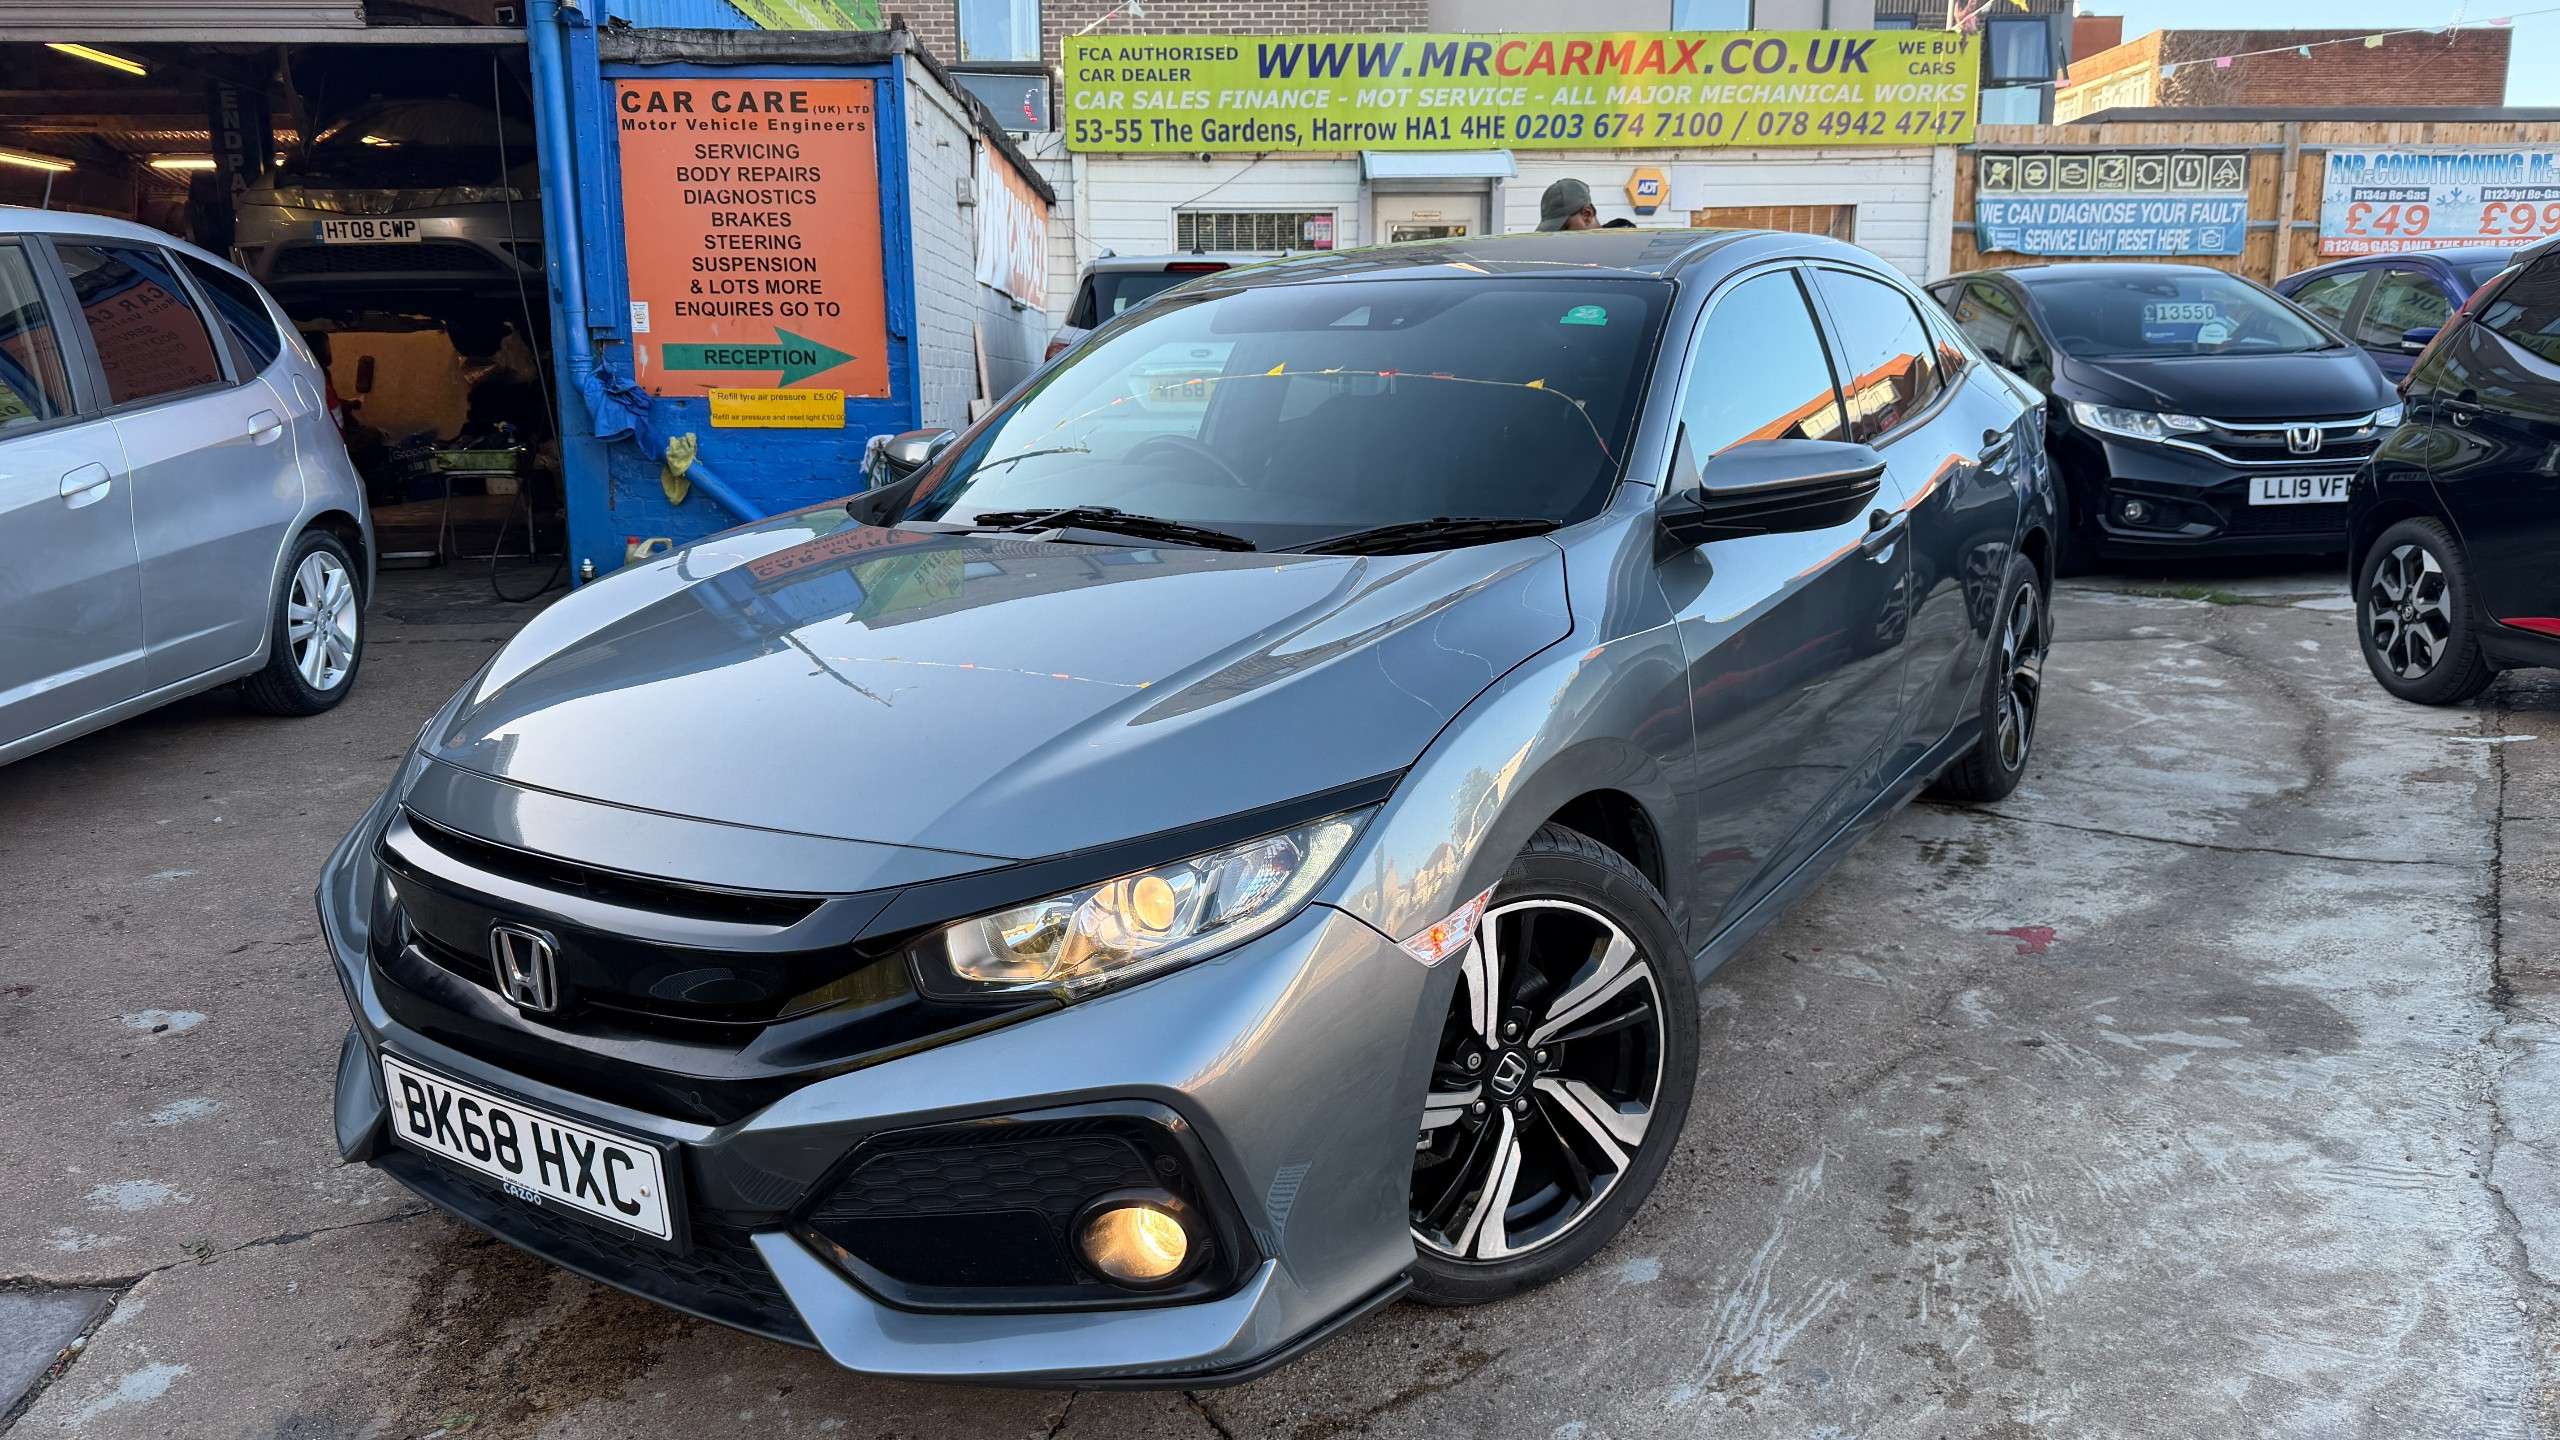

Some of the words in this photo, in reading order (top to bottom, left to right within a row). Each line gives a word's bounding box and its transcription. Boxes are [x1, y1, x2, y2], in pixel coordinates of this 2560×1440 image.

[1078, 47, 1113, 61] FCA
[1118, 46, 1239, 61] AUTHORISED
[1898, 41, 1927, 55] WE
[1932, 40, 1968, 56] BUY
[1257, 38, 1877, 79] WWW.MRCARMAX.CO.UK
[1079, 68, 1116, 82] CAR
[1121, 68, 1192, 82] DEALER
[1908, 61, 1956, 76] CARS
[620, 90, 694, 114] CAR
[711, 90, 809, 114] CARE
[812, 105, 842, 116] (UK)
[846, 105, 870, 114] LTD
[1073, 90, 1125, 110] CAR
[1131, 89, 1211, 110] SALES
[1217, 88, 1331, 110] FINANCE
[1355, 88, 1413, 108] MOT
[1416, 87, 1528, 107] SERVICE
[1550, 86, 1597, 105] ALL
[1604, 85, 1692, 105] MAJOR
[1699, 84, 1864, 105] MECHANICAL
[1874, 83, 1969, 103] WORKS
[621, 118, 677, 131] Motor
[686, 118, 758, 131] Vehicle
[767, 118, 866, 134] Engineers
[1075, 119, 1143, 144] 53-55
[1150, 118, 1193, 143] The
[1200, 117, 1303, 147] Gardens,
[1312, 117, 1397, 142] Harrow
[1405, 116, 1451, 141] HA1
[1460, 115, 1506, 140] 4HE
[1515, 113, 1584, 139] 0203
[1593, 112, 1644, 138] 674
[1653, 112, 1723, 138] 7100
[1756, 111, 1809, 137] 078
[1817, 111, 1886, 136] 4942
[1895, 110, 1967, 136] 4747
[694, 143, 800, 159] SERVICING
[676, 167, 731, 182] BODY
[737, 167, 821, 182] REPAIRS
[1637, 181, 1658, 194] ADT
[2527, 188, 2560, 200] Re-Ga
[683, 189, 817, 205] DIAGNOSTICS
[711, 212, 792, 227] BRAKES
[1980, 203, 2004, 224] WE
[2007, 203, 2046, 224] CAN
[2048, 202, 2138, 224] DIAGNOSE
[2140, 202, 2187, 224] YOUR
[2189, 202, 2245, 223] FAULT
[2344, 202, 2431, 236] £49
[2478, 202, 2560, 236] £99
[324, 221, 375, 239] HT08
[379, 221, 416, 238] CWP
[704, 234, 802, 250] STEERING
[2024, 228, 2078, 251] SERVICE
[2078, 228, 2117, 251] LIGHT
[2115, 228, 2157, 251] RESET
[2156, 228, 2193, 250] HERE
[2370, 240, 2400, 253] GAS
[2401, 240, 2432, 252] AND
[692, 257, 817, 272] SUSPENSION
[690, 280, 704, 294] &
[709, 280, 760, 294] LOTS
[765, 280, 822, 294] MORE
[675, 302, 774, 317] ENQUIRES
[780, 302, 809, 317] GO
[815, 302, 841, 316] TO
[704, 350, 817, 366] RECEPTION
[717, 392, 738, 400] Refill
[740, 392, 756, 402] tyre
[758, 392, 768, 400] air
[770, 393, 807, 402] pressure
[742, 414, 772, 422] pressure
[806, 413, 821, 422] light
[2263, 478, 2312, 499] LL19
[398, 1072, 523, 1175] BK68
[531, 1120, 641, 1217] HXC
[502, 1182, 542, 1206] CAZOO
